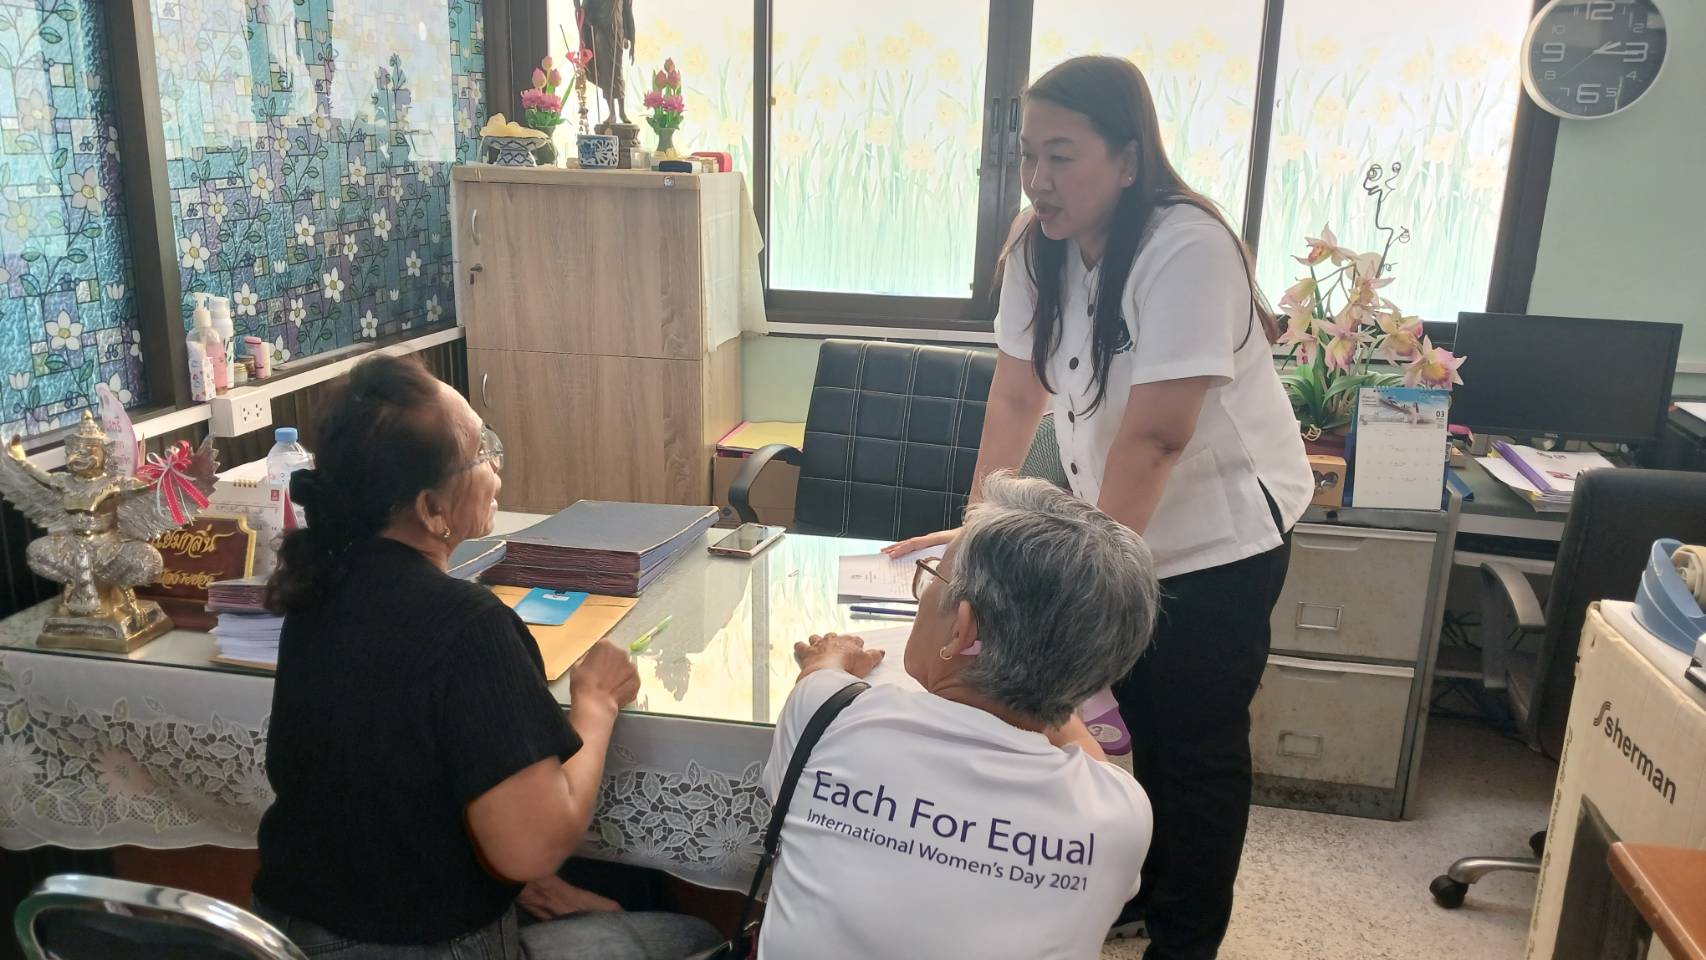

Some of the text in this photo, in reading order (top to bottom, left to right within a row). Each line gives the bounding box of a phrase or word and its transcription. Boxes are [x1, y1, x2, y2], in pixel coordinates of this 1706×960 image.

[1585, 1, 1616, 20] 12
[1552, 25, 1566, 35] 10
[1633, 23, 1645, 33] 2
[1541, 42, 1566, 62] 9
[1623, 42, 1648, 62] 3
[1544, 70, 1556, 80] 8
[1626, 71, 1637, 80] 4
[1560, 87, 1570, 96] 7
[1576, 84, 1600, 104] 6
[1606, 87, 1617, 97] 5
[1604, 716, 1677, 805] sherman
[812, 770, 1095, 866] Each For Equal
[806, 808, 1088, 892] International Women's Day 2021
